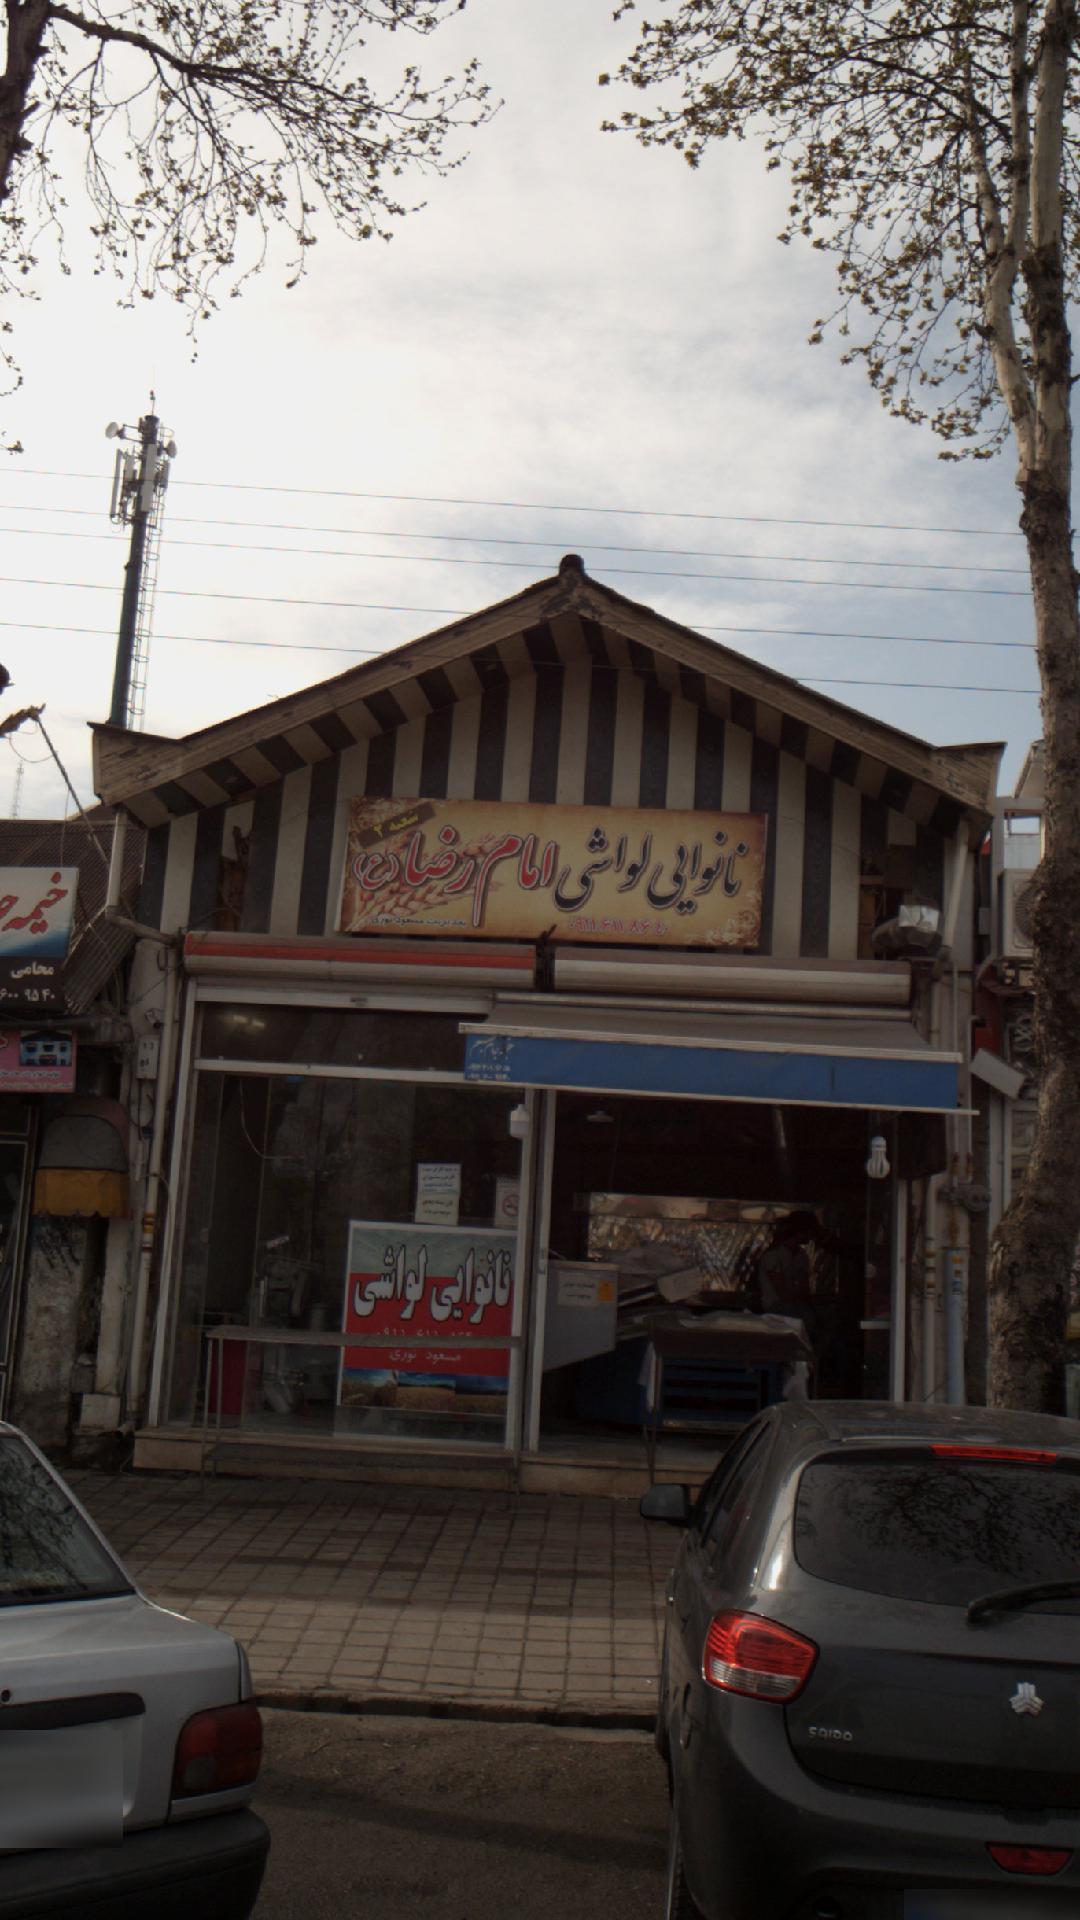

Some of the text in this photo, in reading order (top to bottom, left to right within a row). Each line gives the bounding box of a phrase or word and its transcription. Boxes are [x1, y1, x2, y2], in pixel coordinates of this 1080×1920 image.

[406, 825, 475, 895] رضا
[473, 833, 557, 928] امام
[554, 827, 653, 912] لواشی
[647, 830, 748, 914] نانوایی
[353, 1244, 513, 1325] نانوایی لواشی
[389, 1349, 462, 1366] مسعود نوری
